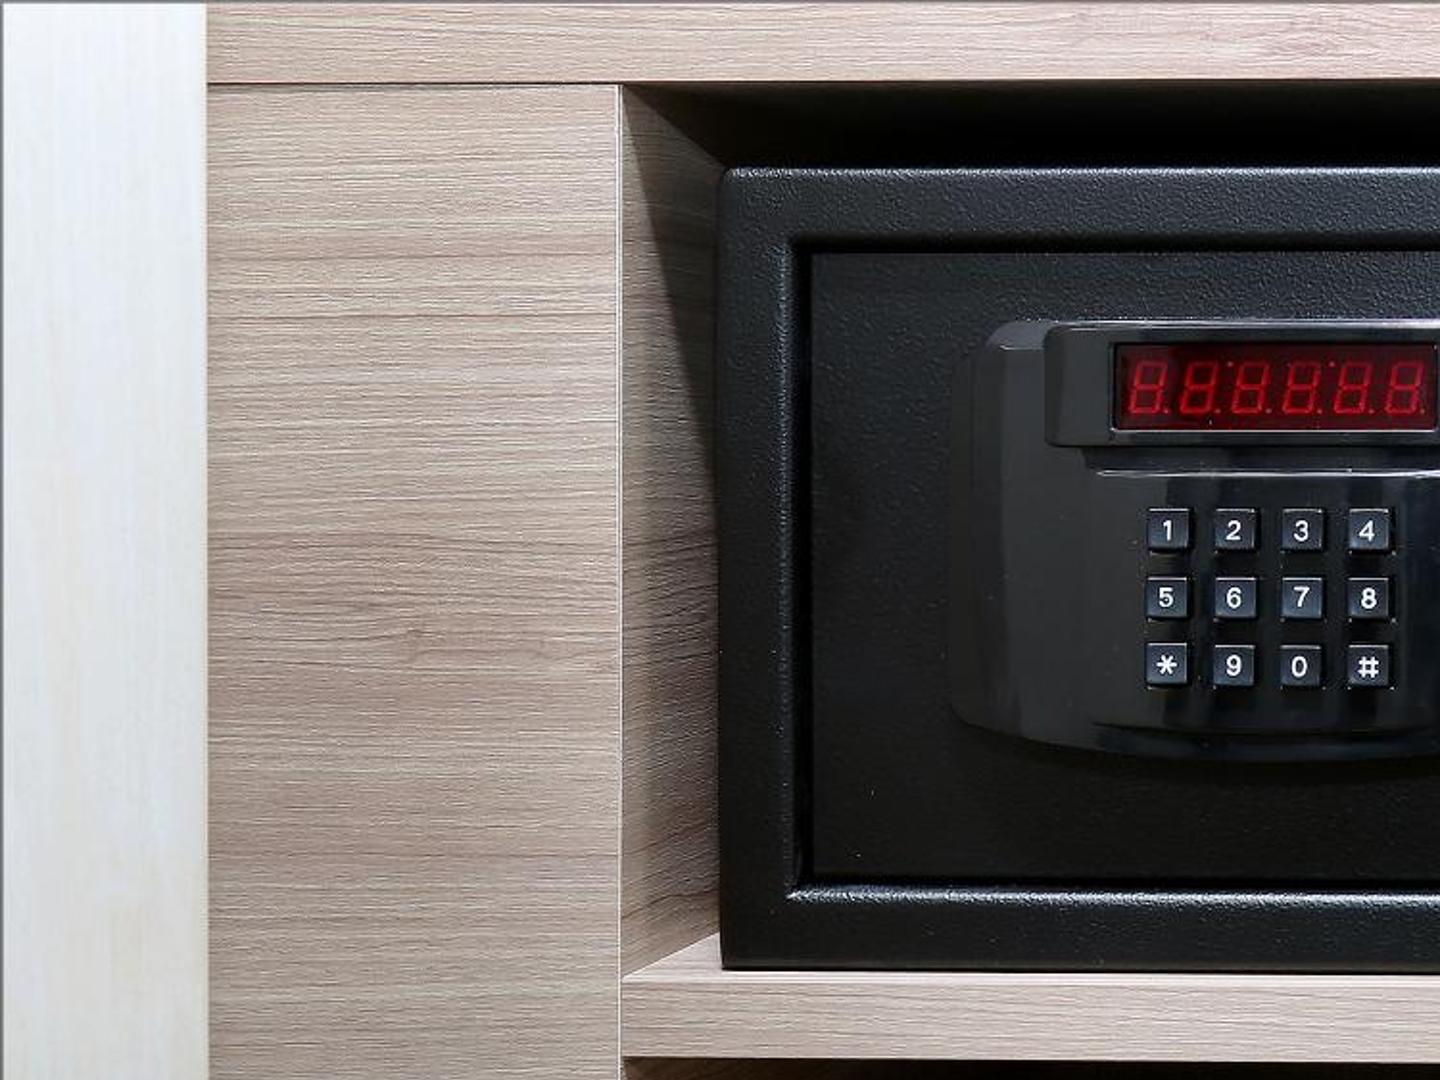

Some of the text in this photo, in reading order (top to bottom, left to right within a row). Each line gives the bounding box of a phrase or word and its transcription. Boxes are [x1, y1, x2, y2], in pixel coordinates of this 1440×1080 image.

[1162, 520, 1375, 542] 1 2 3 4
[1158, 586, 1377, 609] 5 6 7 8
[1226, 655, 1242, 676] 9
[1291, 656, 1307, 677] 0
